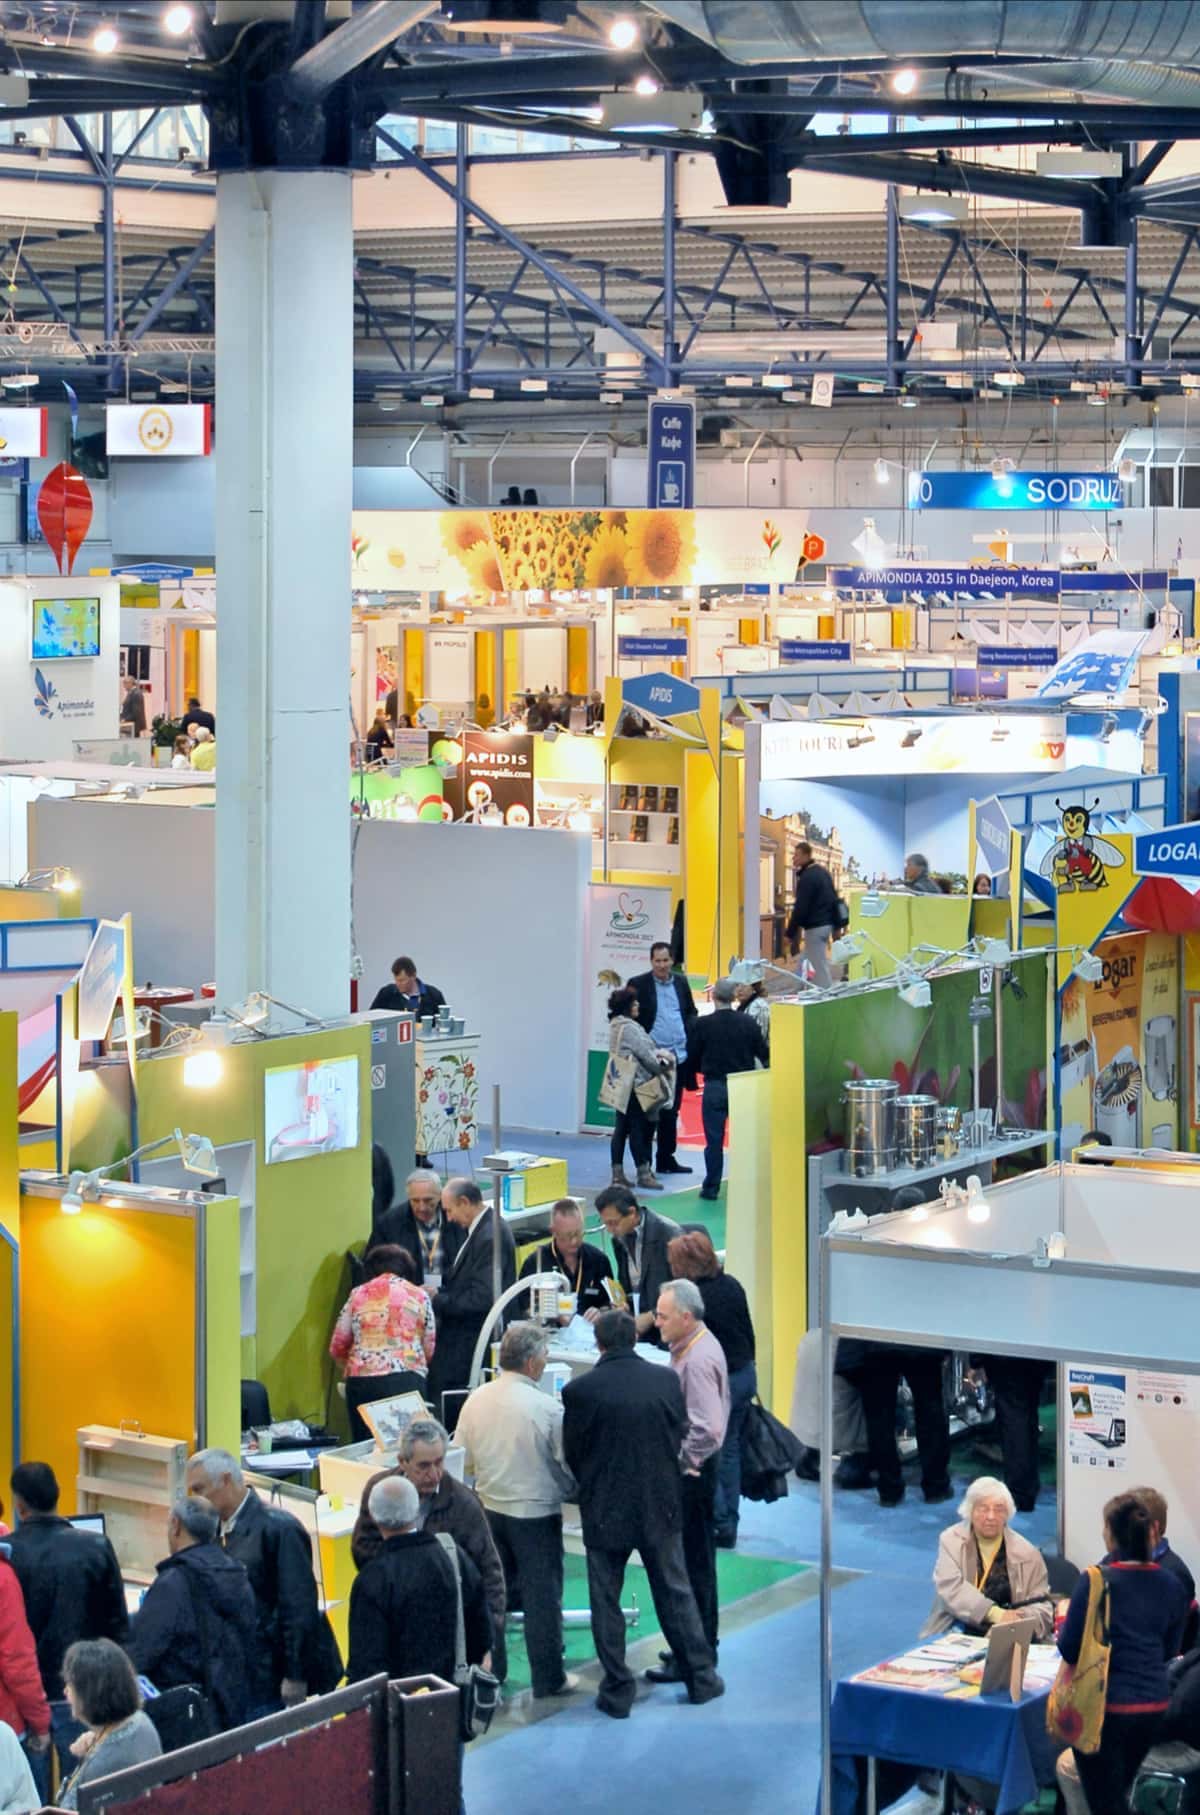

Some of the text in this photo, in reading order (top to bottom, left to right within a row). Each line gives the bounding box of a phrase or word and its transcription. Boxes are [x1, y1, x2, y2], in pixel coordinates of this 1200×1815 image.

[662, 417, 682, 430] Caffe
[661, 436, 682, 452] Кафе
[1027, 479, 1124, 502] SODRUZ
[926, 572, 953, 585] 2015
[956, 573, 967, 585] in
[970, 574, 1019, 588] Daejeon,
[1021, 575, 1054, 586] Korea
[649, 686, 673, 703] APIDIS
[466, 752, 528, 765] APIDIS
[1149, 842, 1200, 862] LOGA
